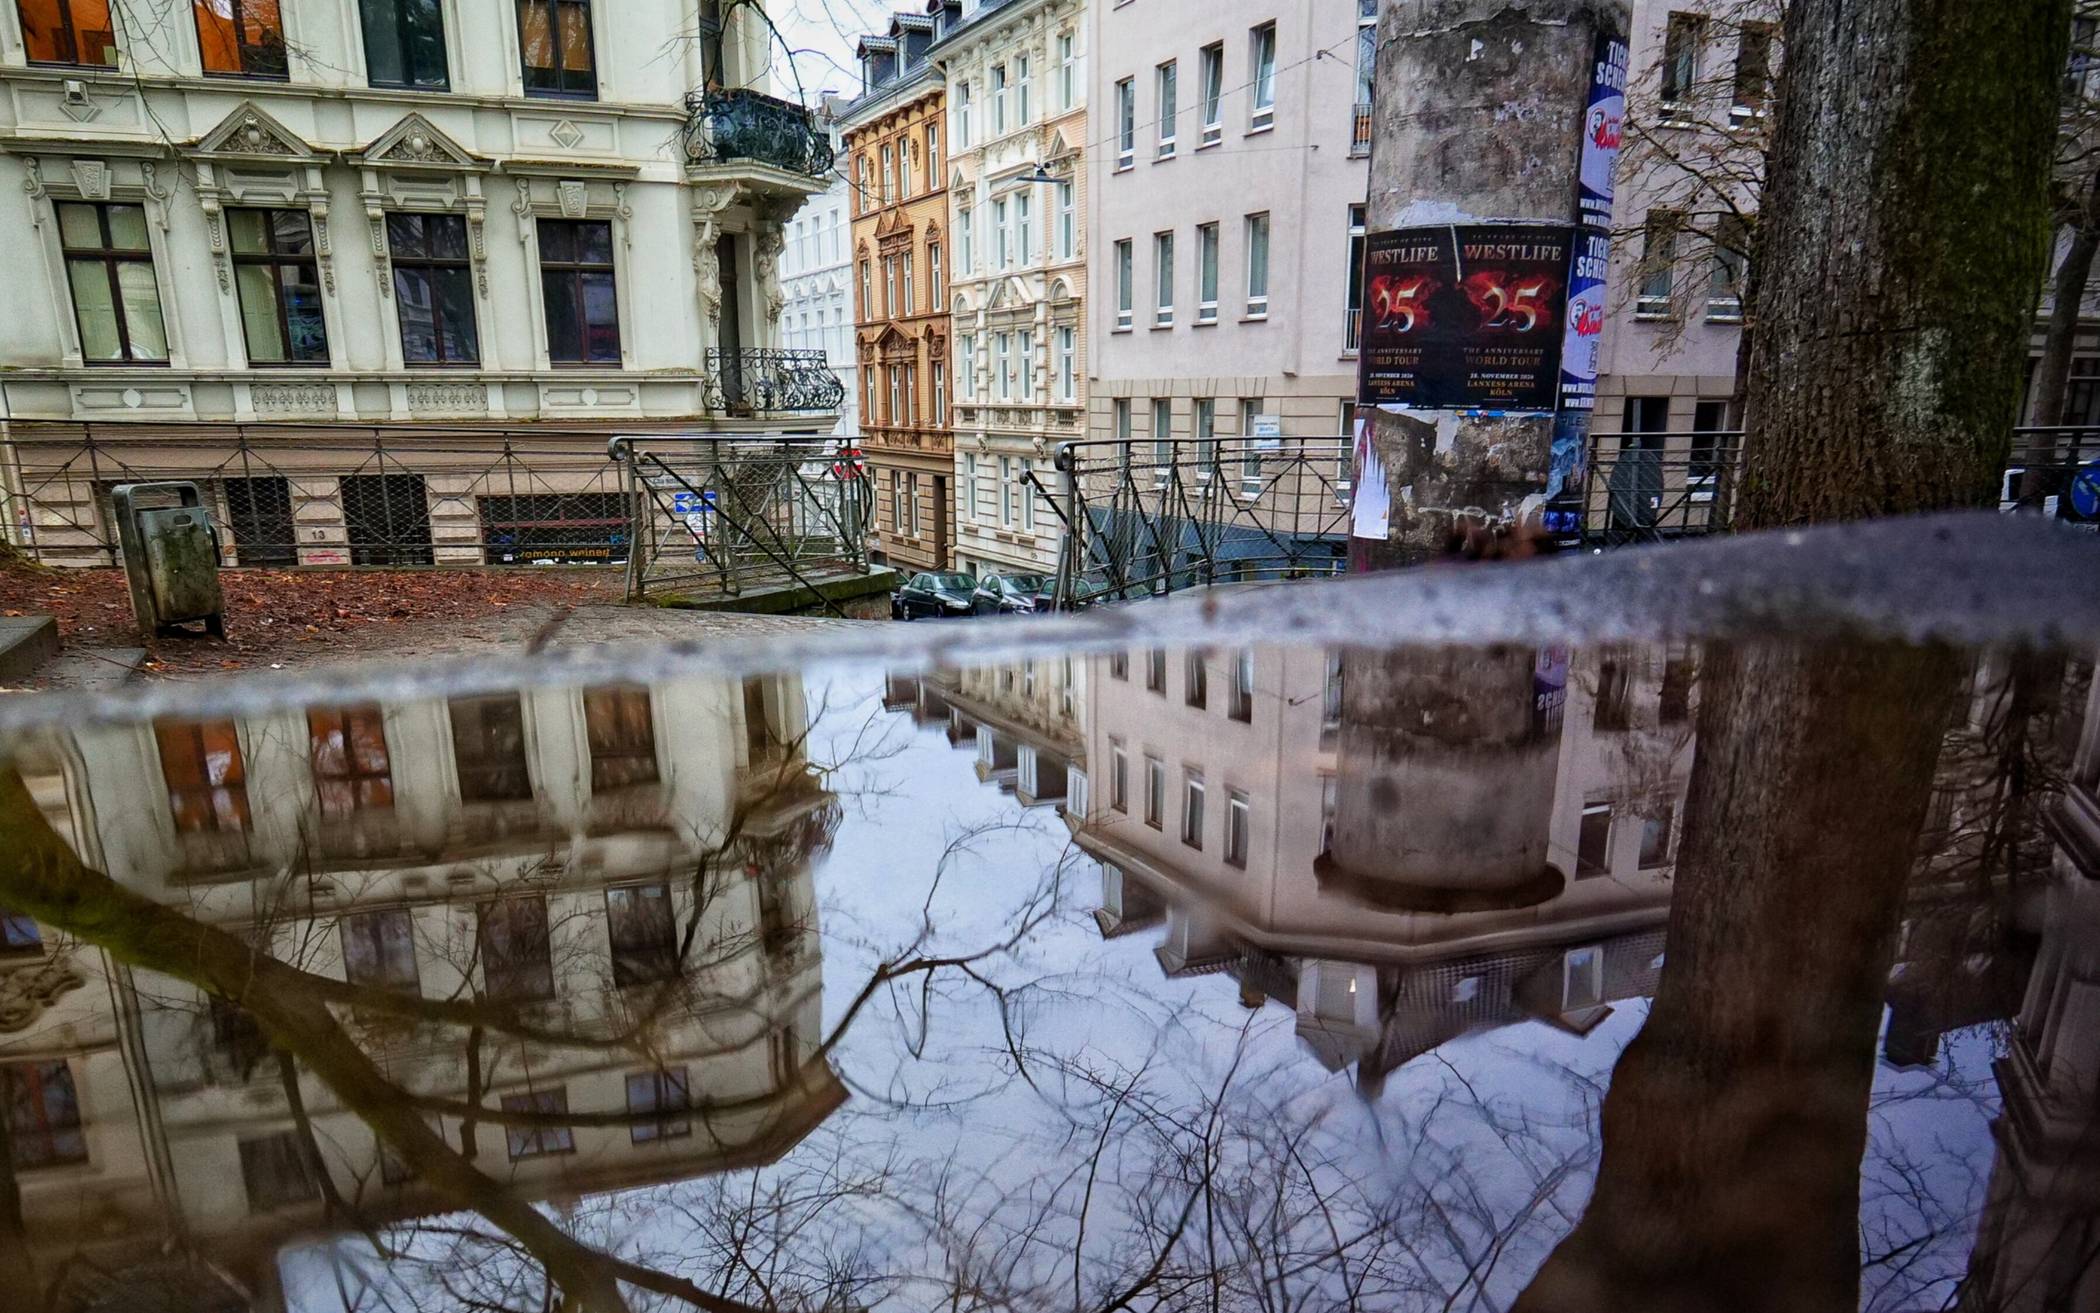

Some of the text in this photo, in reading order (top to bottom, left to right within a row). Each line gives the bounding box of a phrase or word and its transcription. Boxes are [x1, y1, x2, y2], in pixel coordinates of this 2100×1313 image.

[1370, 246, 1438, 264] WESTLIFE
[1464, 244, 1562, 261] WESTLIFE
[1376, 281, 1422, 332] 25
[1482, 281, 1544, 332] 25
[1394, 356, 1419, 366] TOUR
[1465, 355, 1541, 366] WORLD TOUR
[1490, 388, 1513, 396] KÖLN
[311, 530, 326, 540] 13
